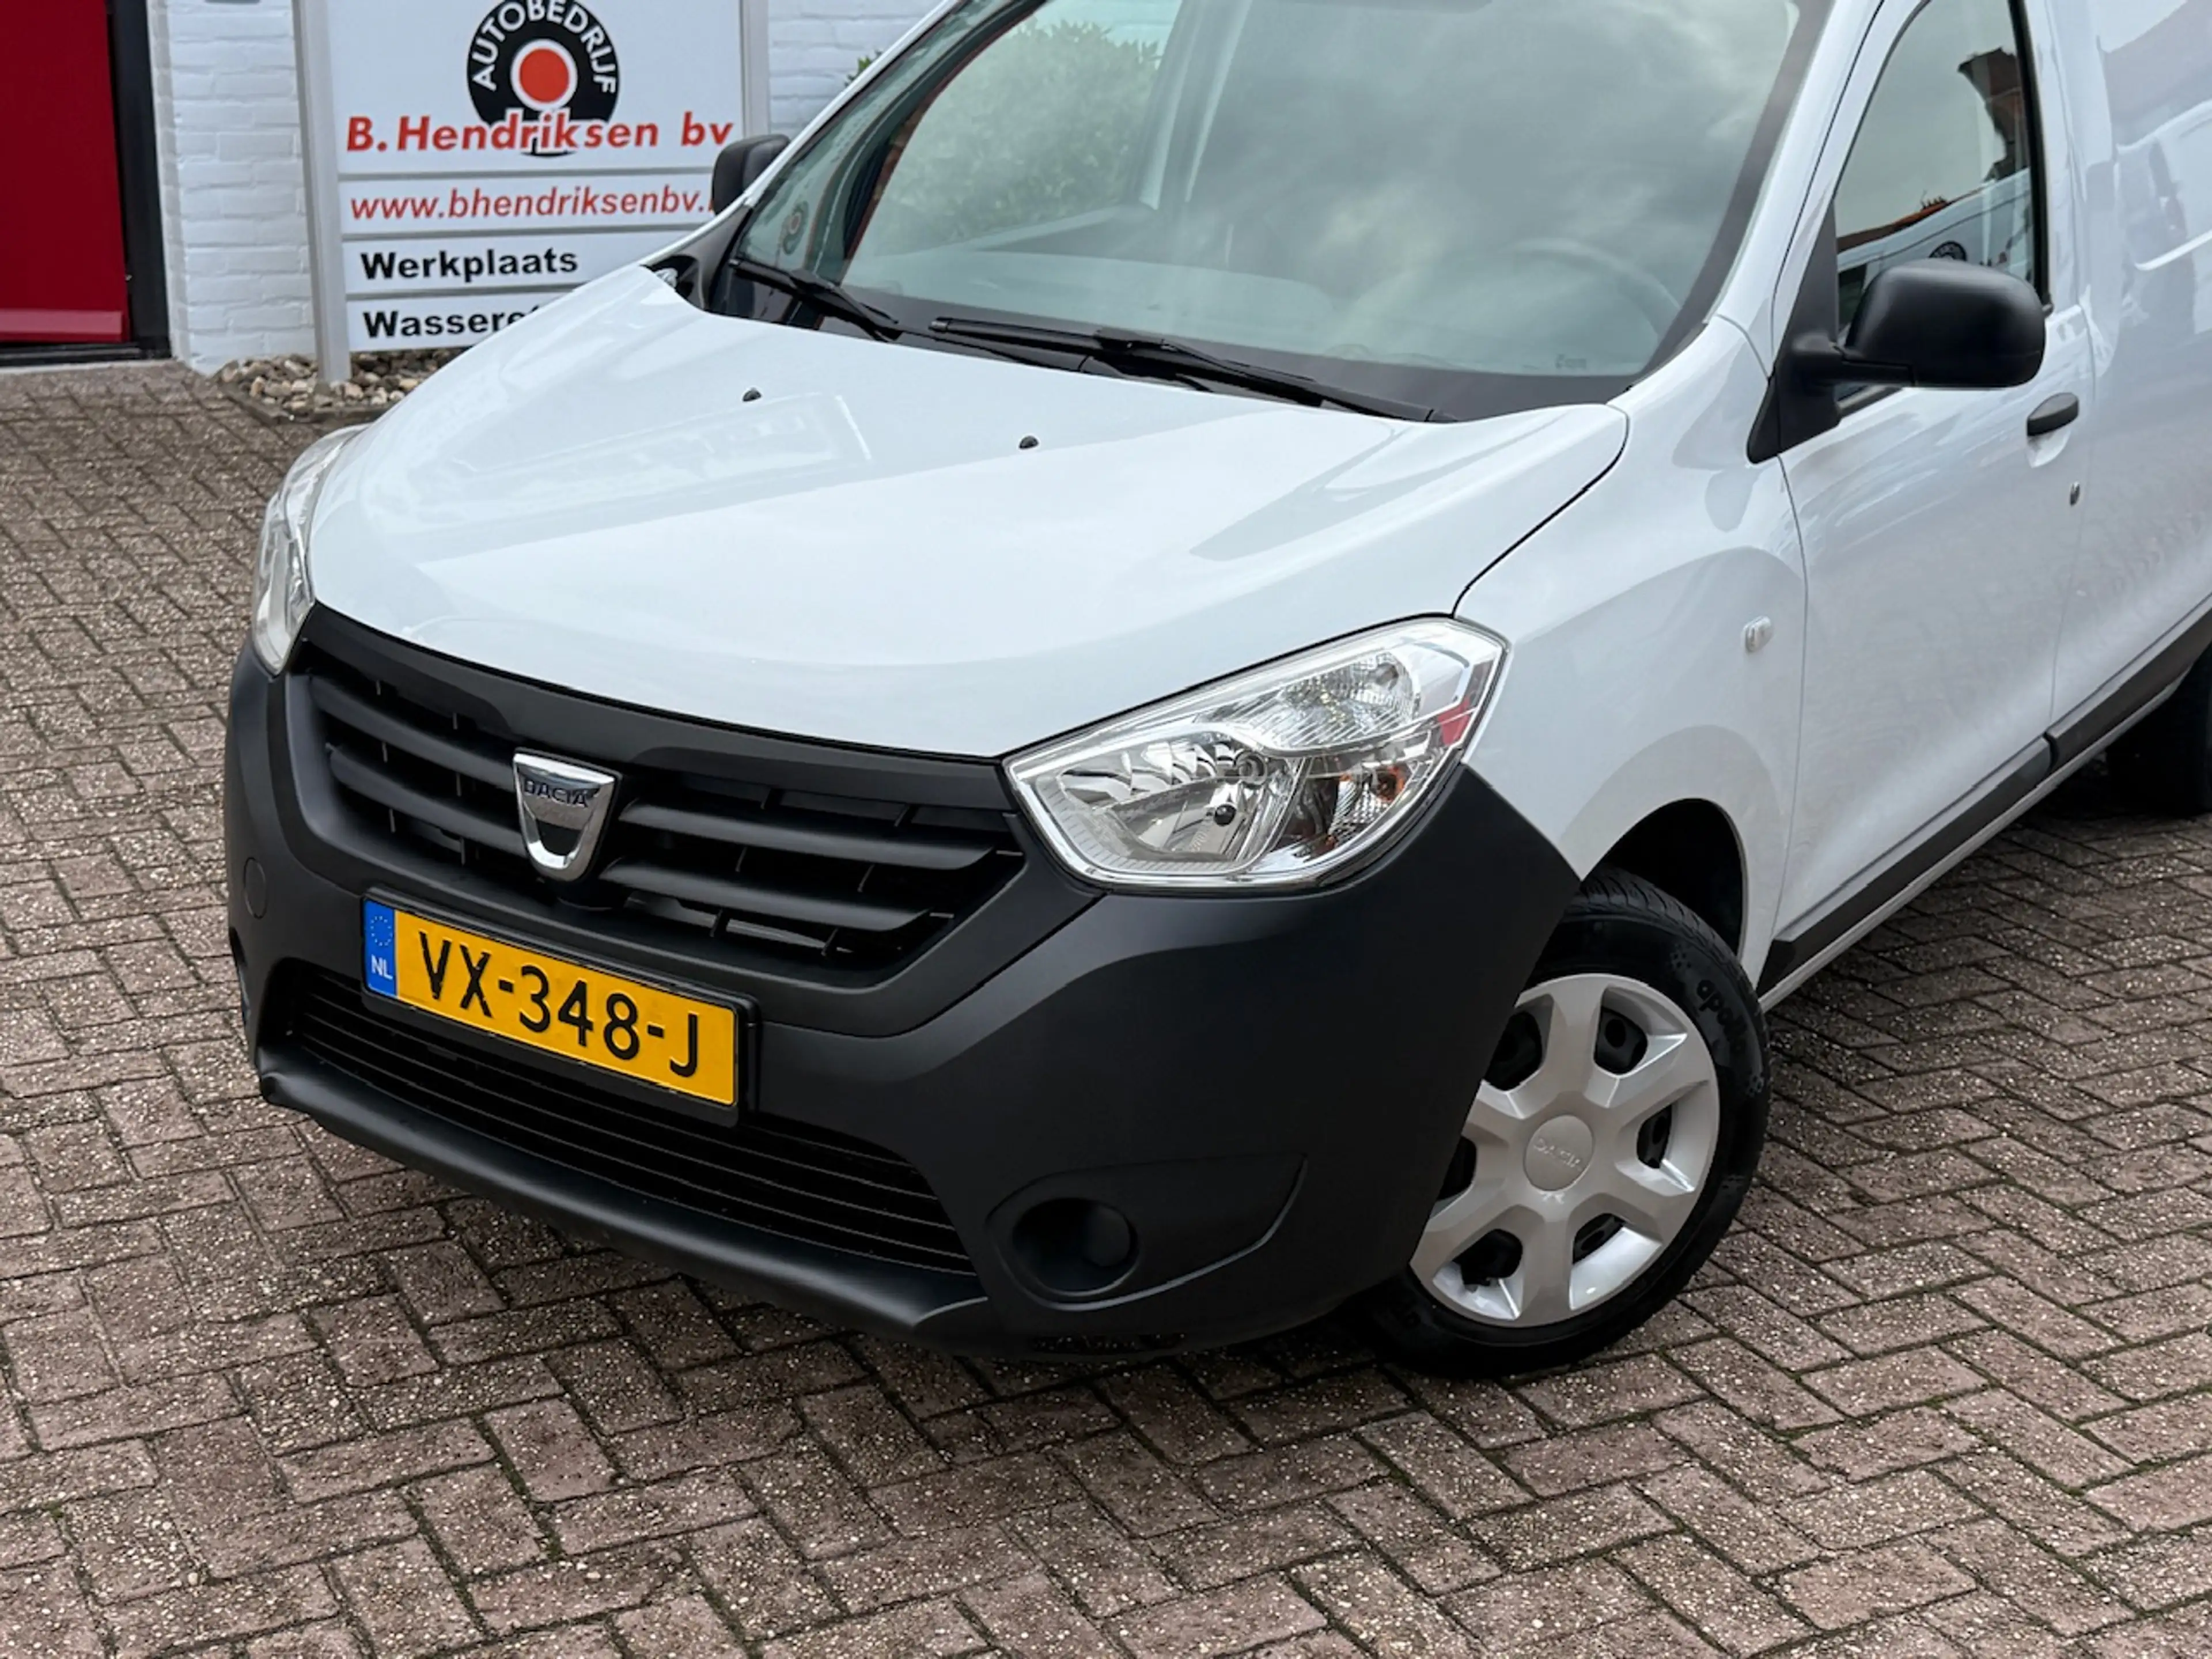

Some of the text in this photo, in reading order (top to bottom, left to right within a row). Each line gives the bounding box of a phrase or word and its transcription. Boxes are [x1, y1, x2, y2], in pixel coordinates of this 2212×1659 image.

[471, 0, 616, 94] AUTOBEDRIJF
[680, 111, 733, 147] bv
[360, 248, 578, 283] Werkplaats
[363, 305, 540, 338] Wassere
[524, 779, 589, 808] DACIA
[371, 955, 393, 979] NL
[419, 931, 699, 1078] VX-348-J
